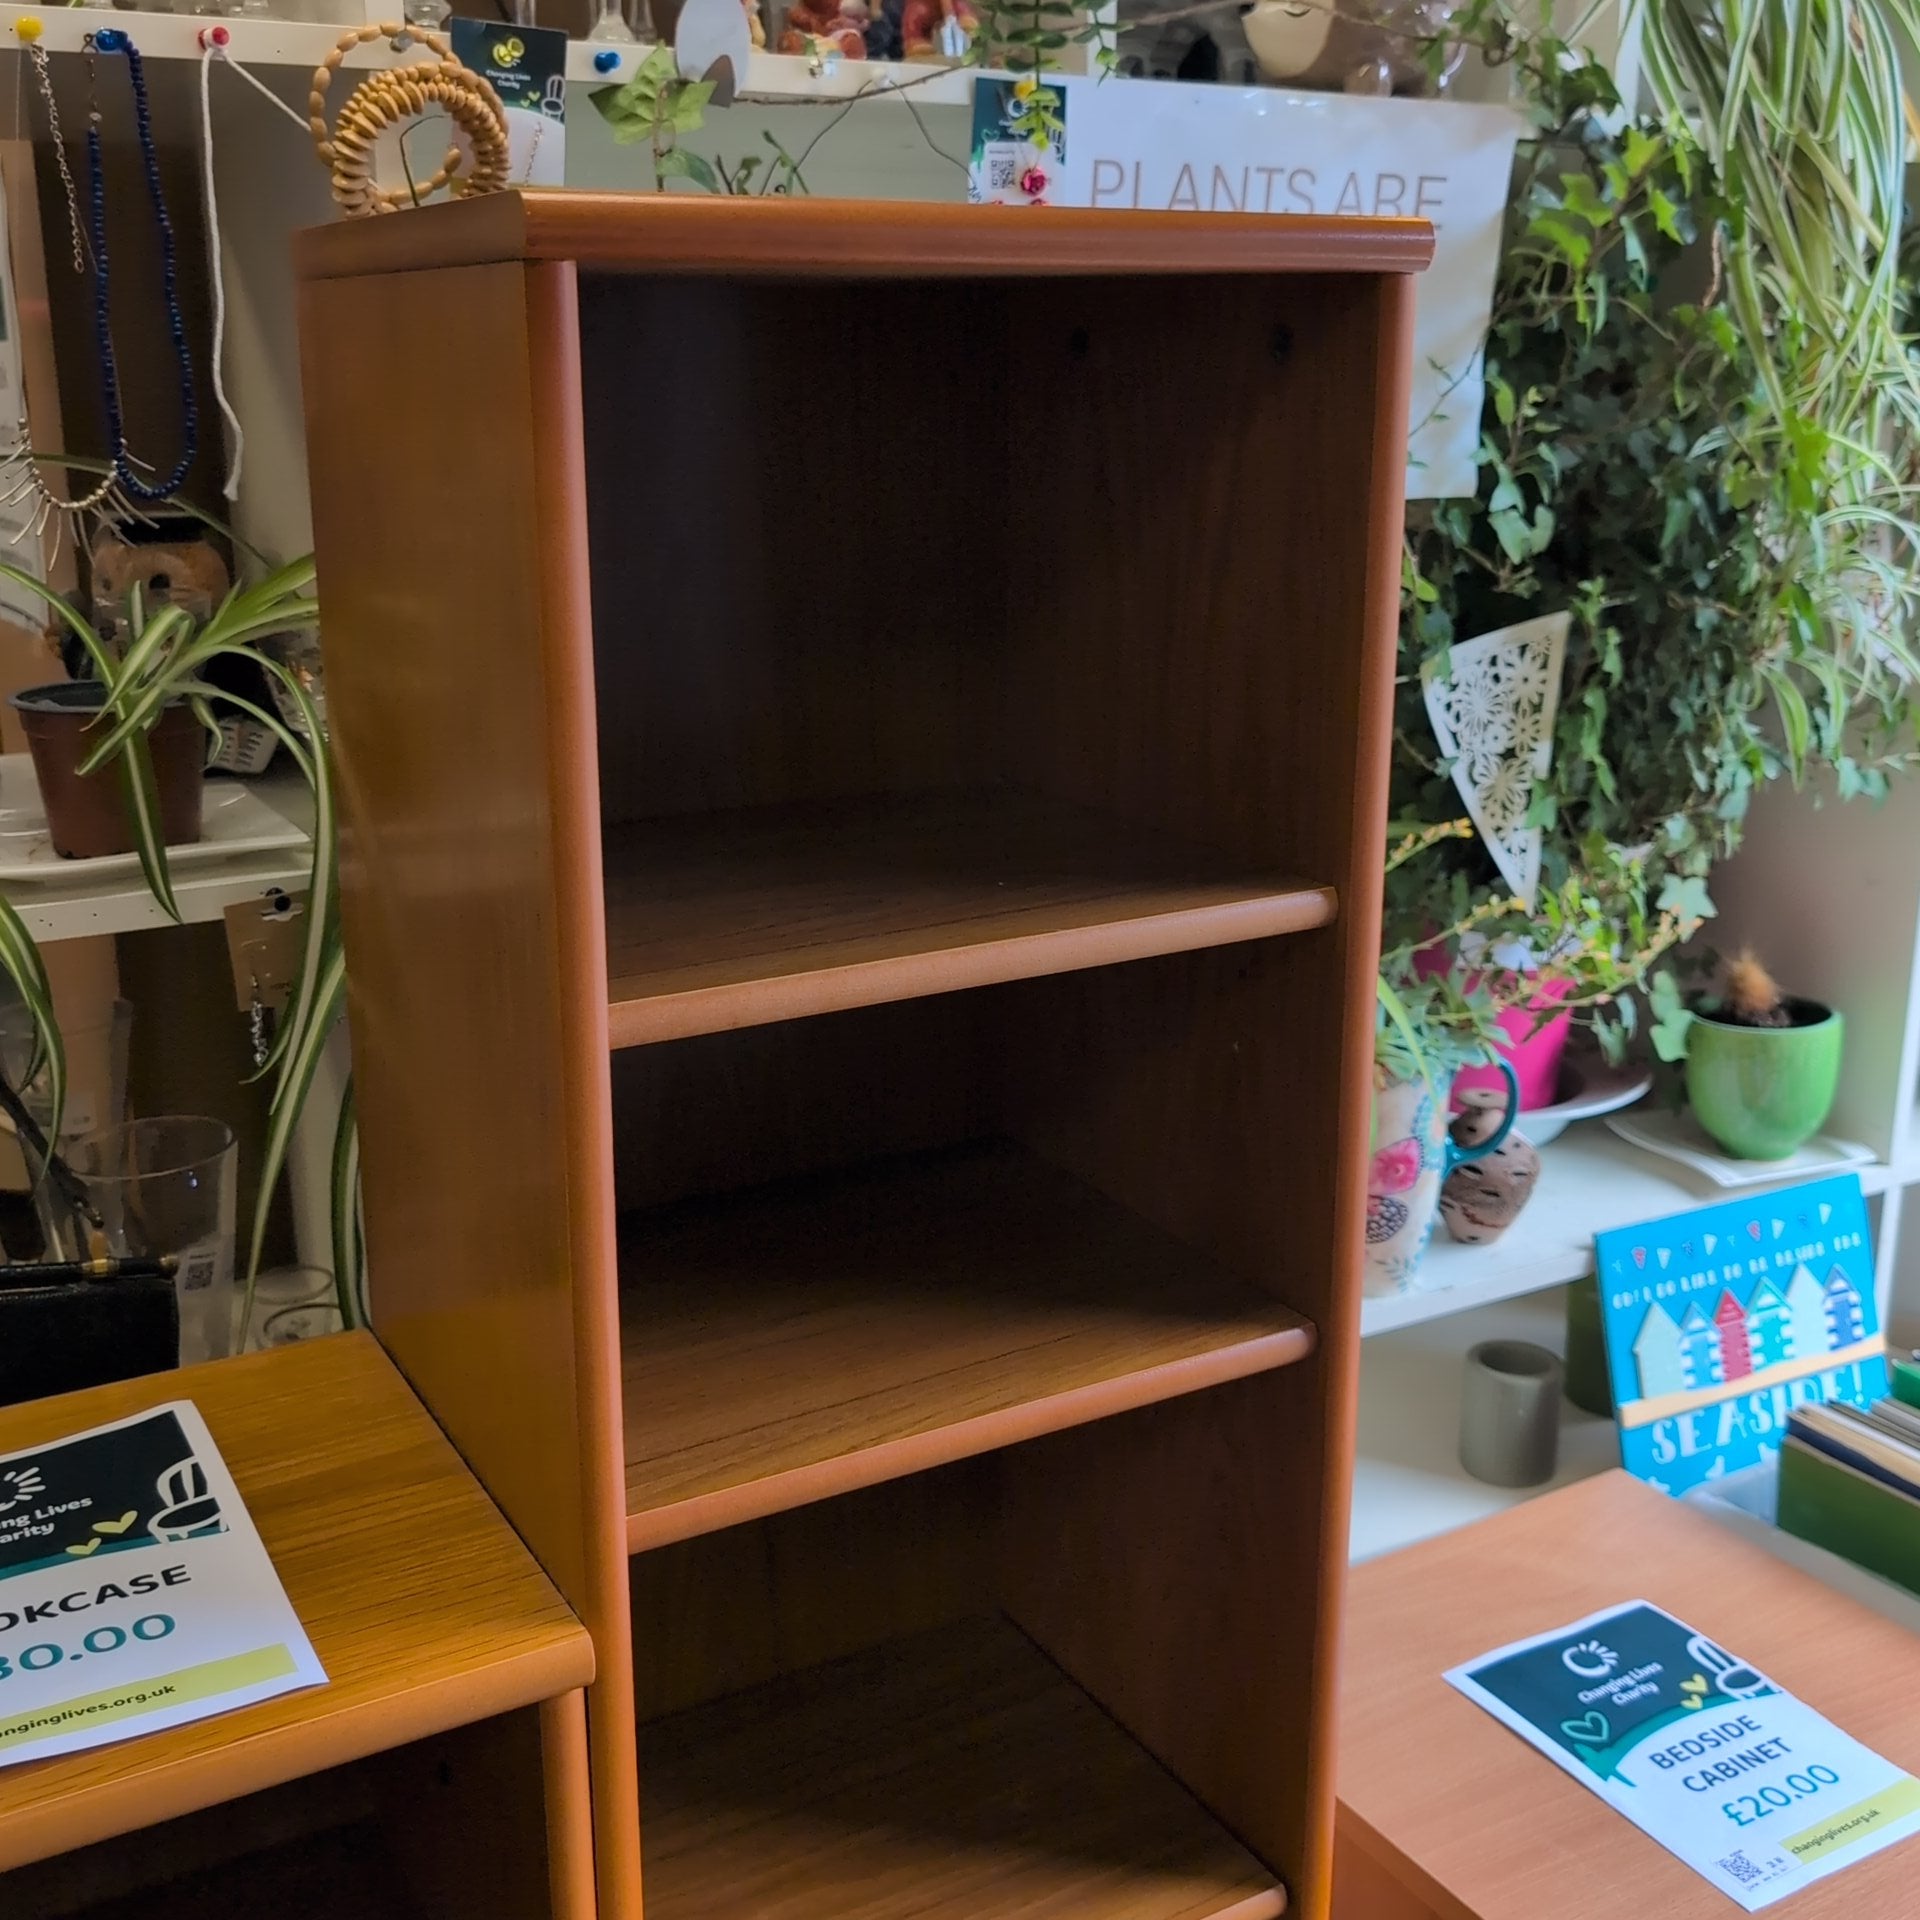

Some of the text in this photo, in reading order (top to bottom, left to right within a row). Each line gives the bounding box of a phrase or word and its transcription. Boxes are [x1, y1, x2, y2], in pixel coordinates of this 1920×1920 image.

[1090, 158, 1448, 229] PLANTS ARE
[0, 1497, 93, 1530] ng Lives
[1577, 1662, 1664, 1704] Changing Lives
[1612, 1681, 1661, 1706] Charity
[1649, 1714, 1762, 1770] BEDSIDE
[1682, 1737, 1793, 1793] CABINET
[1721, 1764, 1840, 1827] £20.00
[1791, 1809, 1881, 1855] changinglives.org.uk
